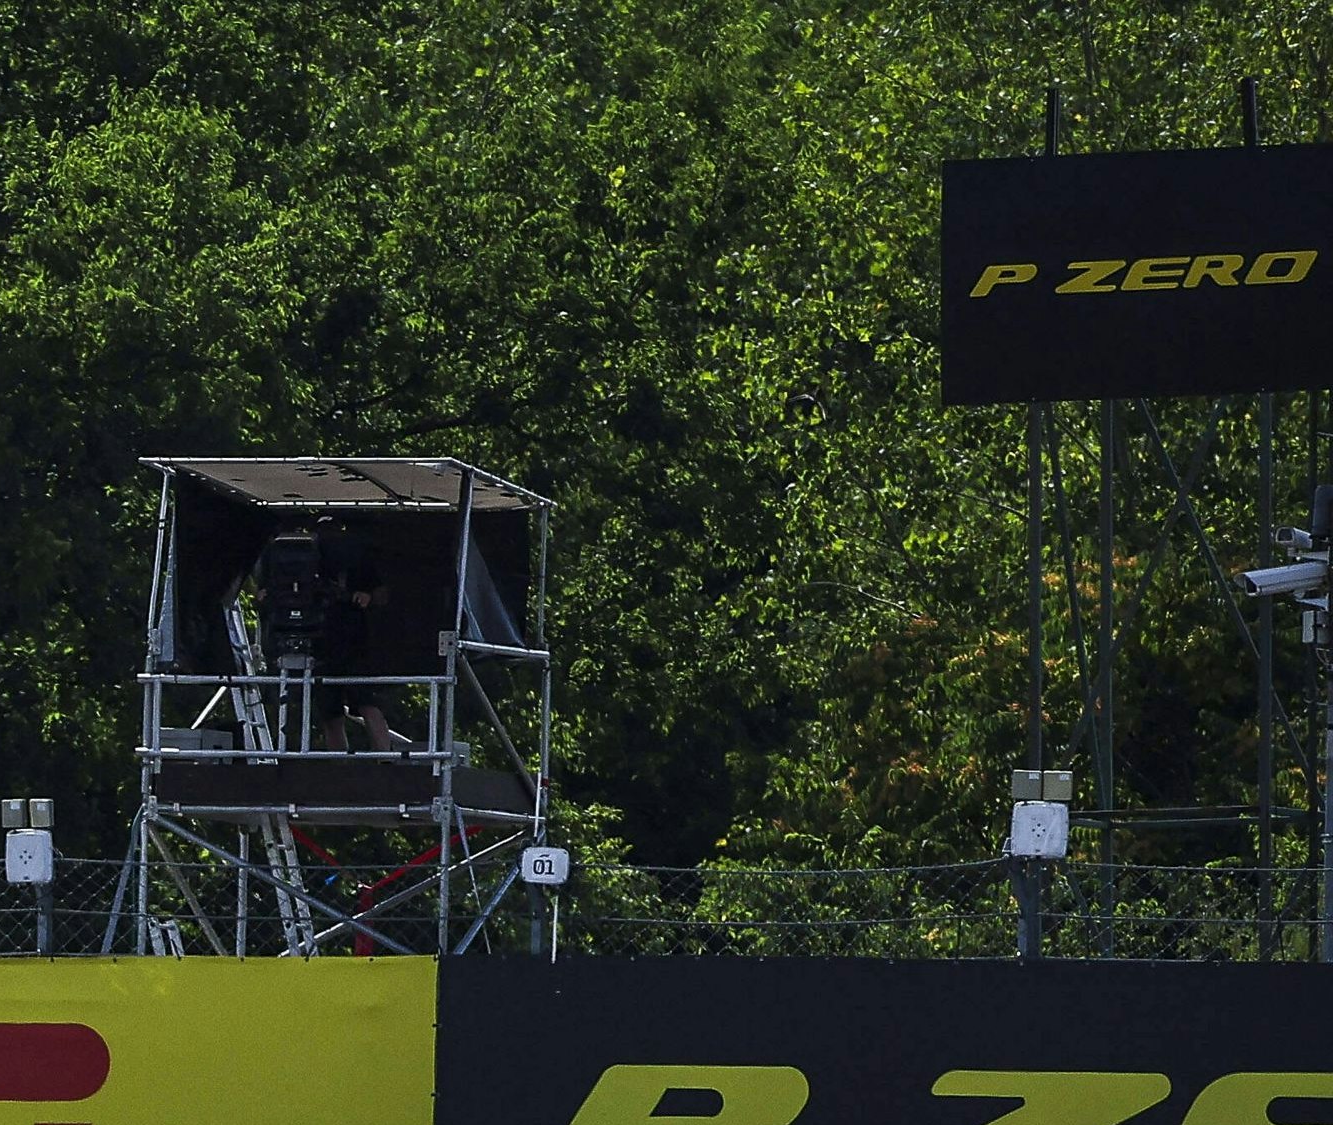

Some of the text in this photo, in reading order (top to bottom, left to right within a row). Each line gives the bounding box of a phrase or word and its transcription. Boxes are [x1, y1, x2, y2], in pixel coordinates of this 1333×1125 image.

[969, 250, 1319, 298] P ZERO
[533, 859, 555, 875] 01
